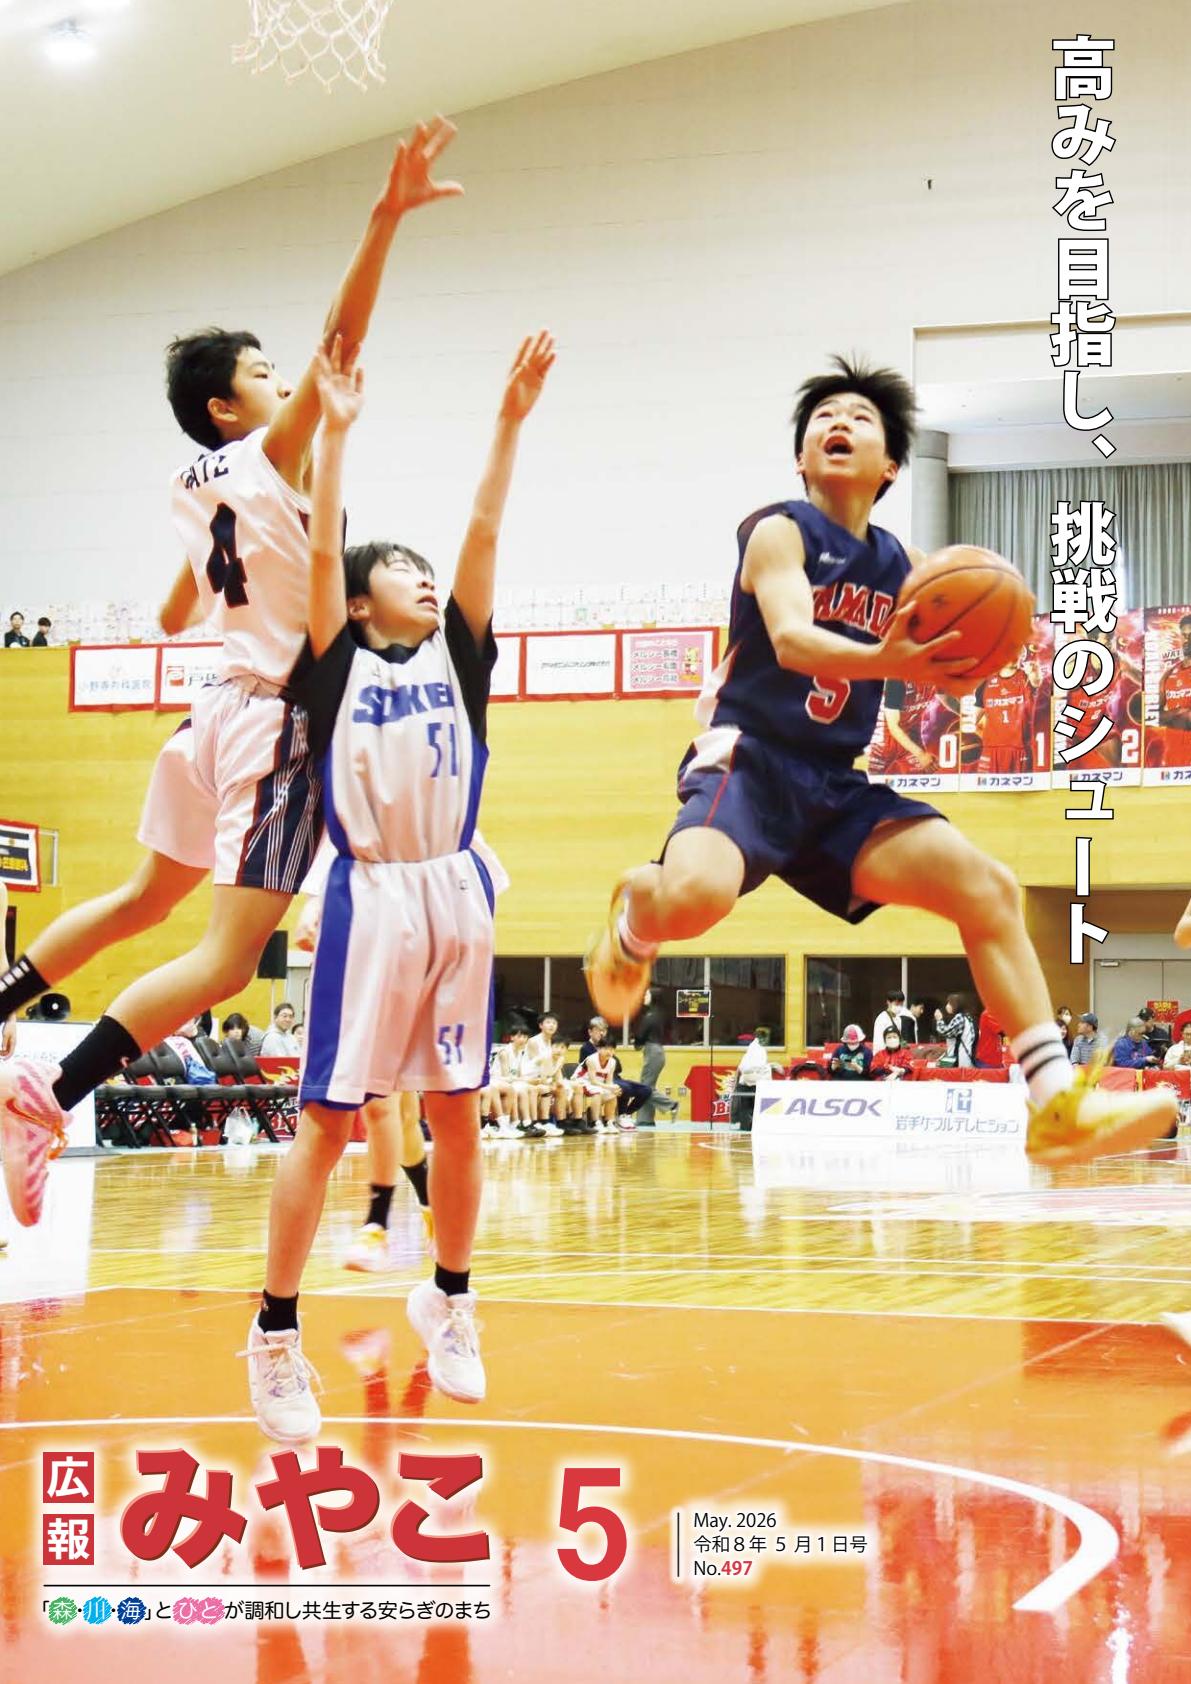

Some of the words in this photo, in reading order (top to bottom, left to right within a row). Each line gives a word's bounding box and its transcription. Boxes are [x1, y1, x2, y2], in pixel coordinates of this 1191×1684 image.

[206, 502, 249, 609] 4
[427, 722, 458, 778] 51
[938, 734, 958, 769] 0
[1034, 732, 1046, 767] 1
[1121, 729, 1139, 764] 2
[989, 775, 1033, 787] カネマン
[784, 1098, 883, 1117] ALSOK
